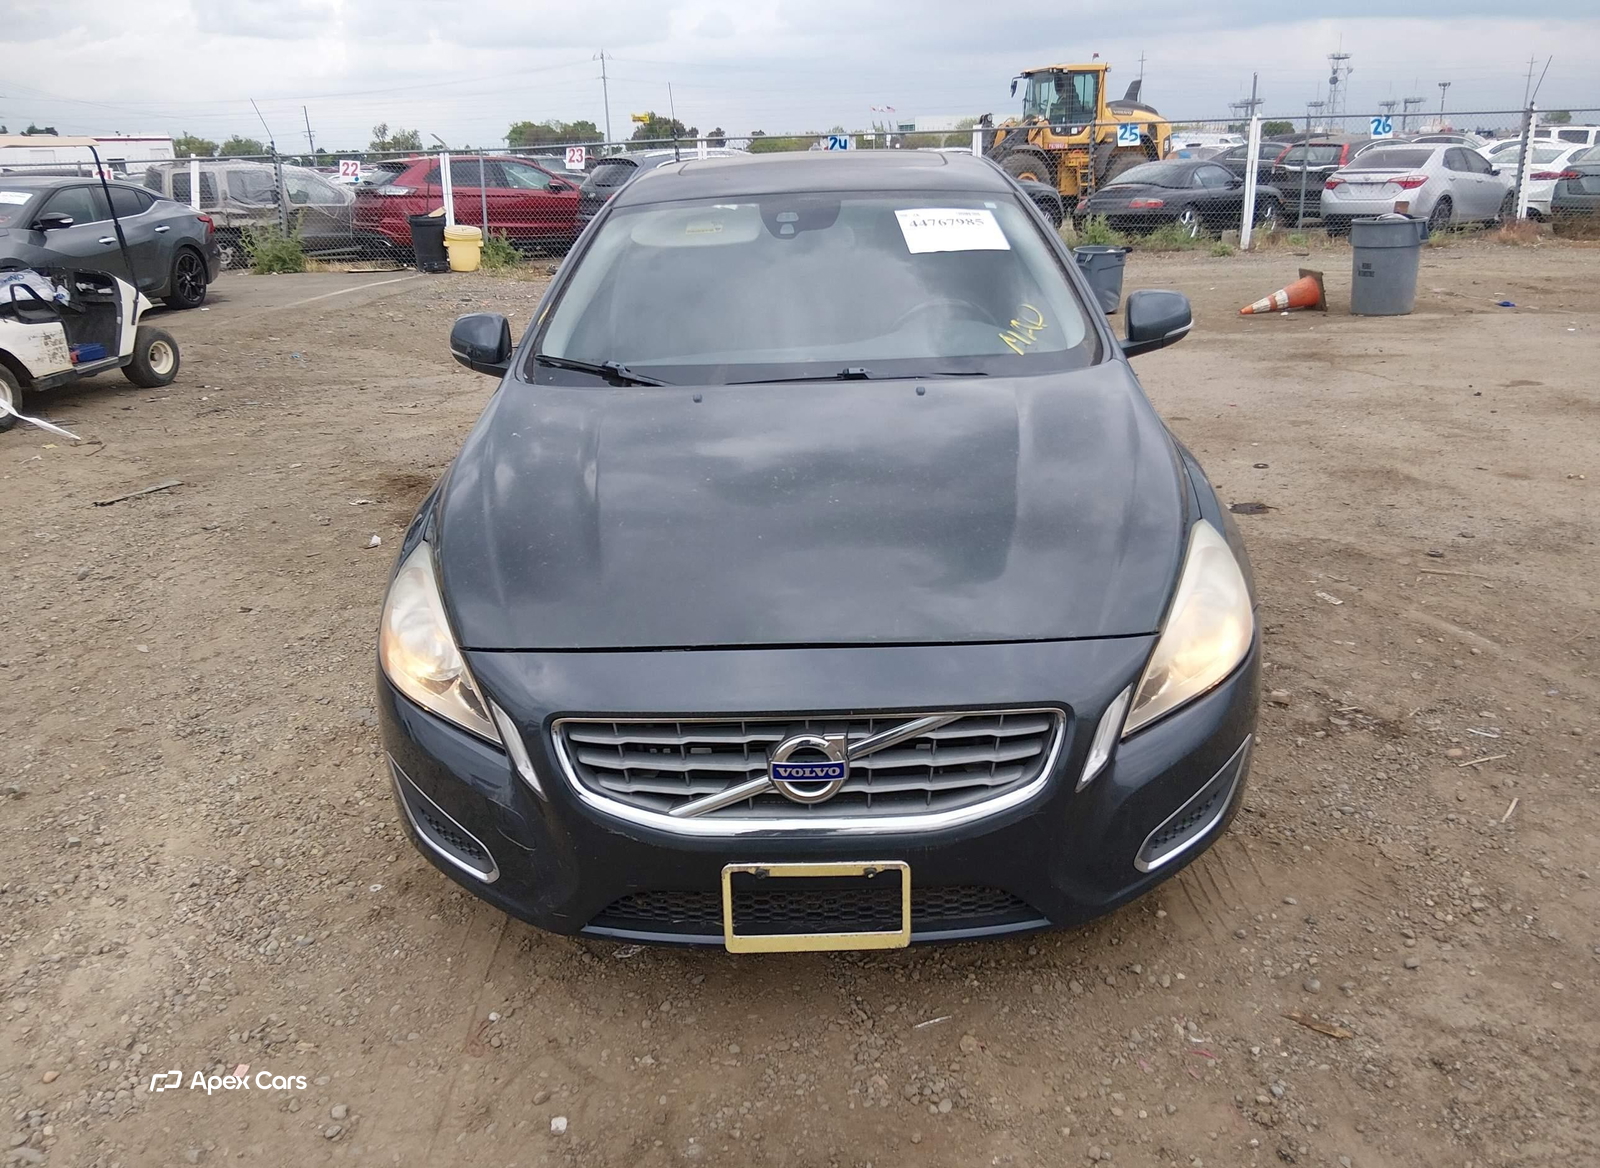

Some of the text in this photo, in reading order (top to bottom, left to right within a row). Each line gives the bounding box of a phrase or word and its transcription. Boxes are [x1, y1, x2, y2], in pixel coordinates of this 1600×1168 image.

[1370, 115, 1392, 135] 26
[1119, 124, 1139, 142] 25
[568, 148, 584, 163] 23
[341, 161, 359, 176] 22
[909, 218, 985, 228] 44767985
[776, 766, 840, 777] VOLVO
